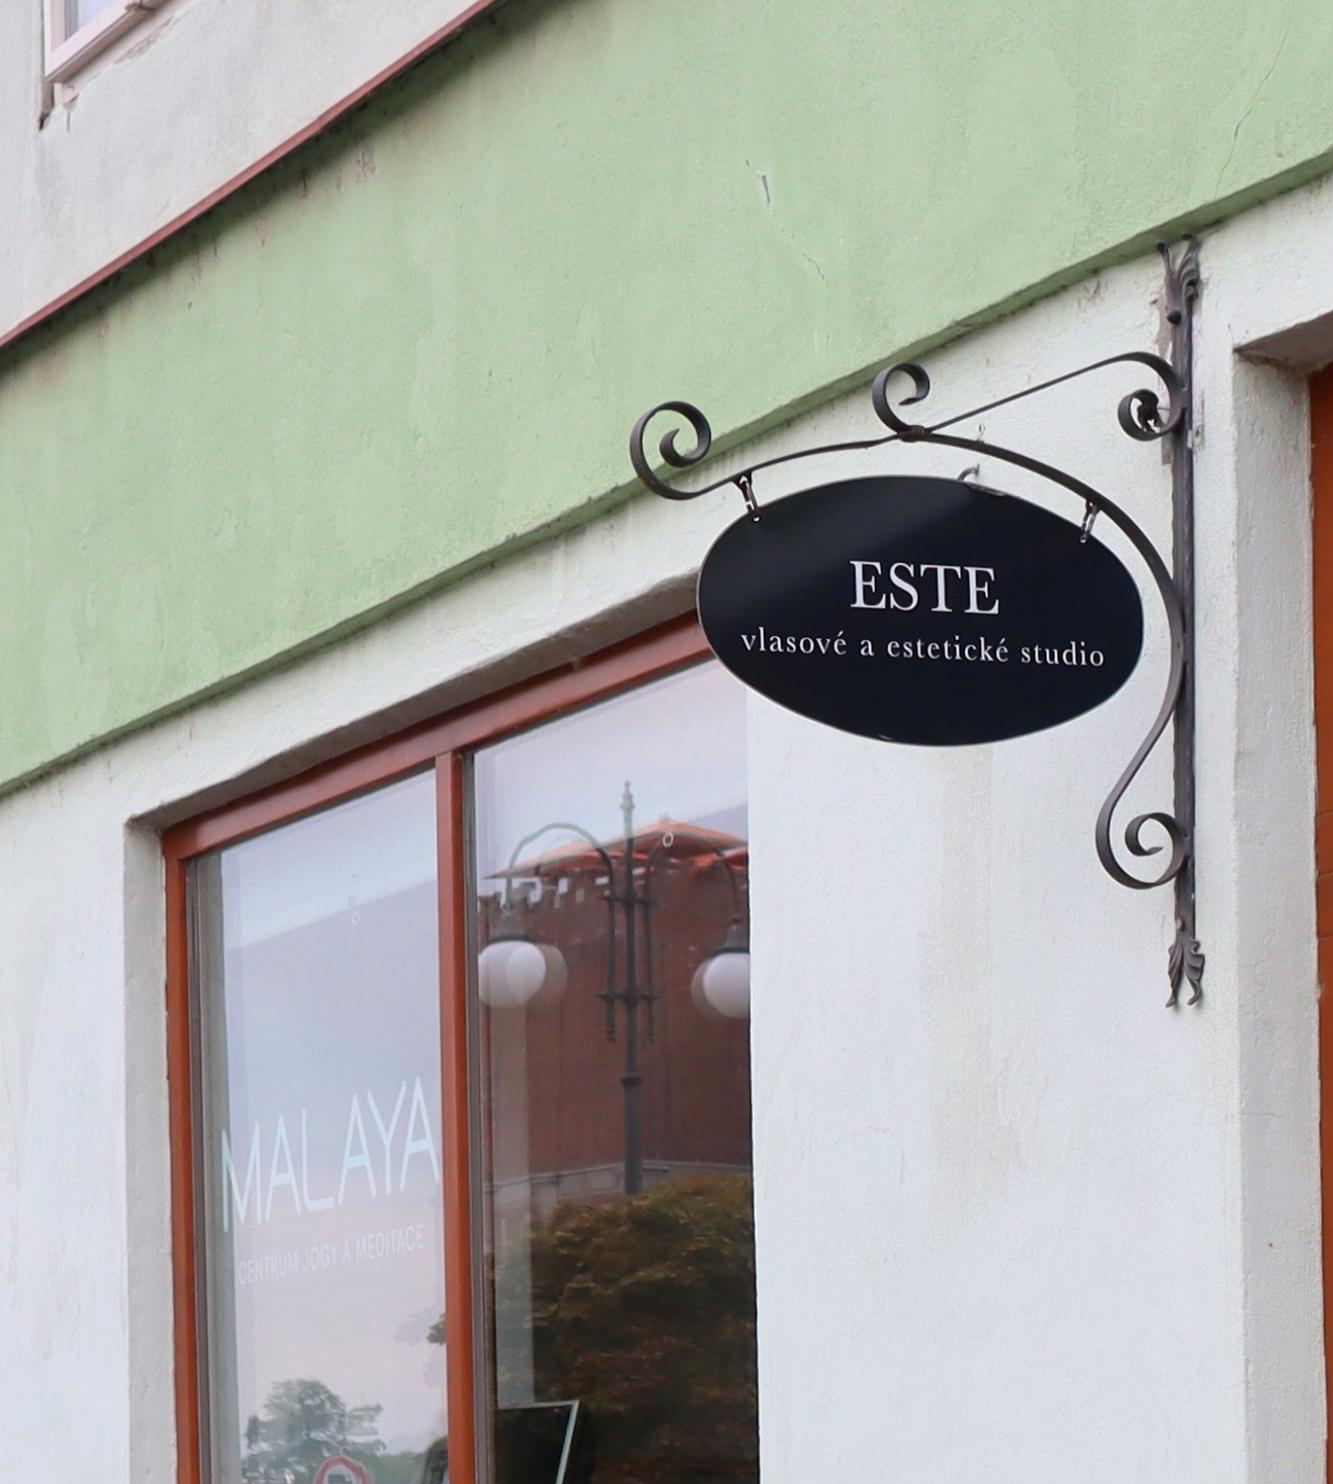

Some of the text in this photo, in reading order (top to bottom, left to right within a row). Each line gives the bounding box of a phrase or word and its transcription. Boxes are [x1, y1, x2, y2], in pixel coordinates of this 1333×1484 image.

[849, 560, 1000, 615] ESTE
[740, 627, 1105, 668] vlasové a estetické studio
[221, 1075, 441, 1233] MALAYA
[237, 1248, 300, 1286] CENTRUM
[342, 1239, 352, 1264] A
[355, 1224, 425, 1261] MEDITACE
